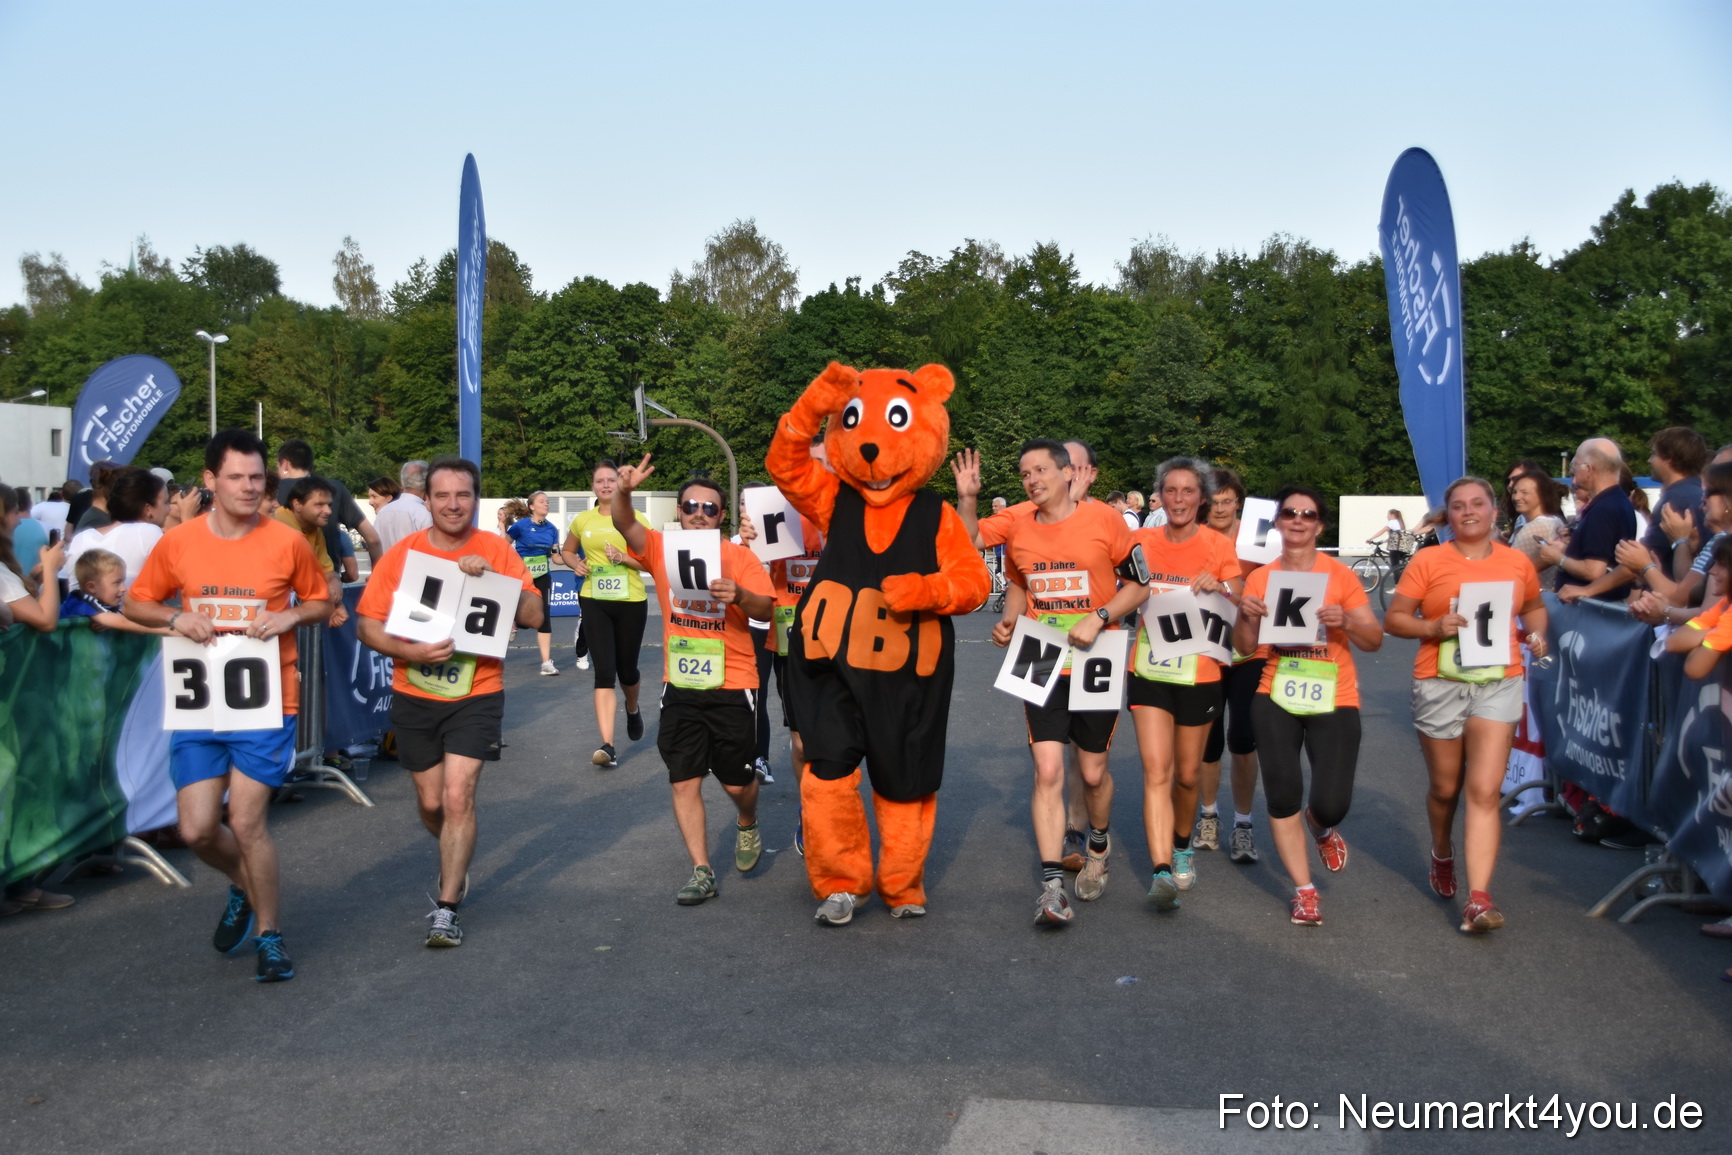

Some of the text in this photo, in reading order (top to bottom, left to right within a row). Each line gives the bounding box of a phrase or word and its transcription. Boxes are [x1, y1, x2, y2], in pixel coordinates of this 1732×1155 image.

[96, 374, 155, 453] Fischer
[117, 389, 164, 452] AUTOMOBILE
[763, 512, 785, 544] r
[678, 550, 710, 590] h
[1032, 561, 1076, 571] 30 Jahre
[597, 579, 621, 590] 682
[1030, 576, 1083, 593] OBI
[1150, 572, 1190, 583] 30 Jahre
[201, 585, 256, 597] 30 Jahre
[550, 590, 578, 600] isch
[197, 603, 261, 621] OBI
[1032, 597, 1092, 610] Neumarkt
[1273, 588, 1312, 627] k
[670, 613, 726, 631] Neumarkt
[801, 580, 942, 676] OBI
[1474, 602, 1493, 647] t
[421, 664, 459, 684] 616
[678, 658, 712, 675] 624
[1284, 680, 1323, 701] 618
[1567, 678, 1621, 747] Fischer
[1566, 739, 1625, 780] AUTOMOBILE
